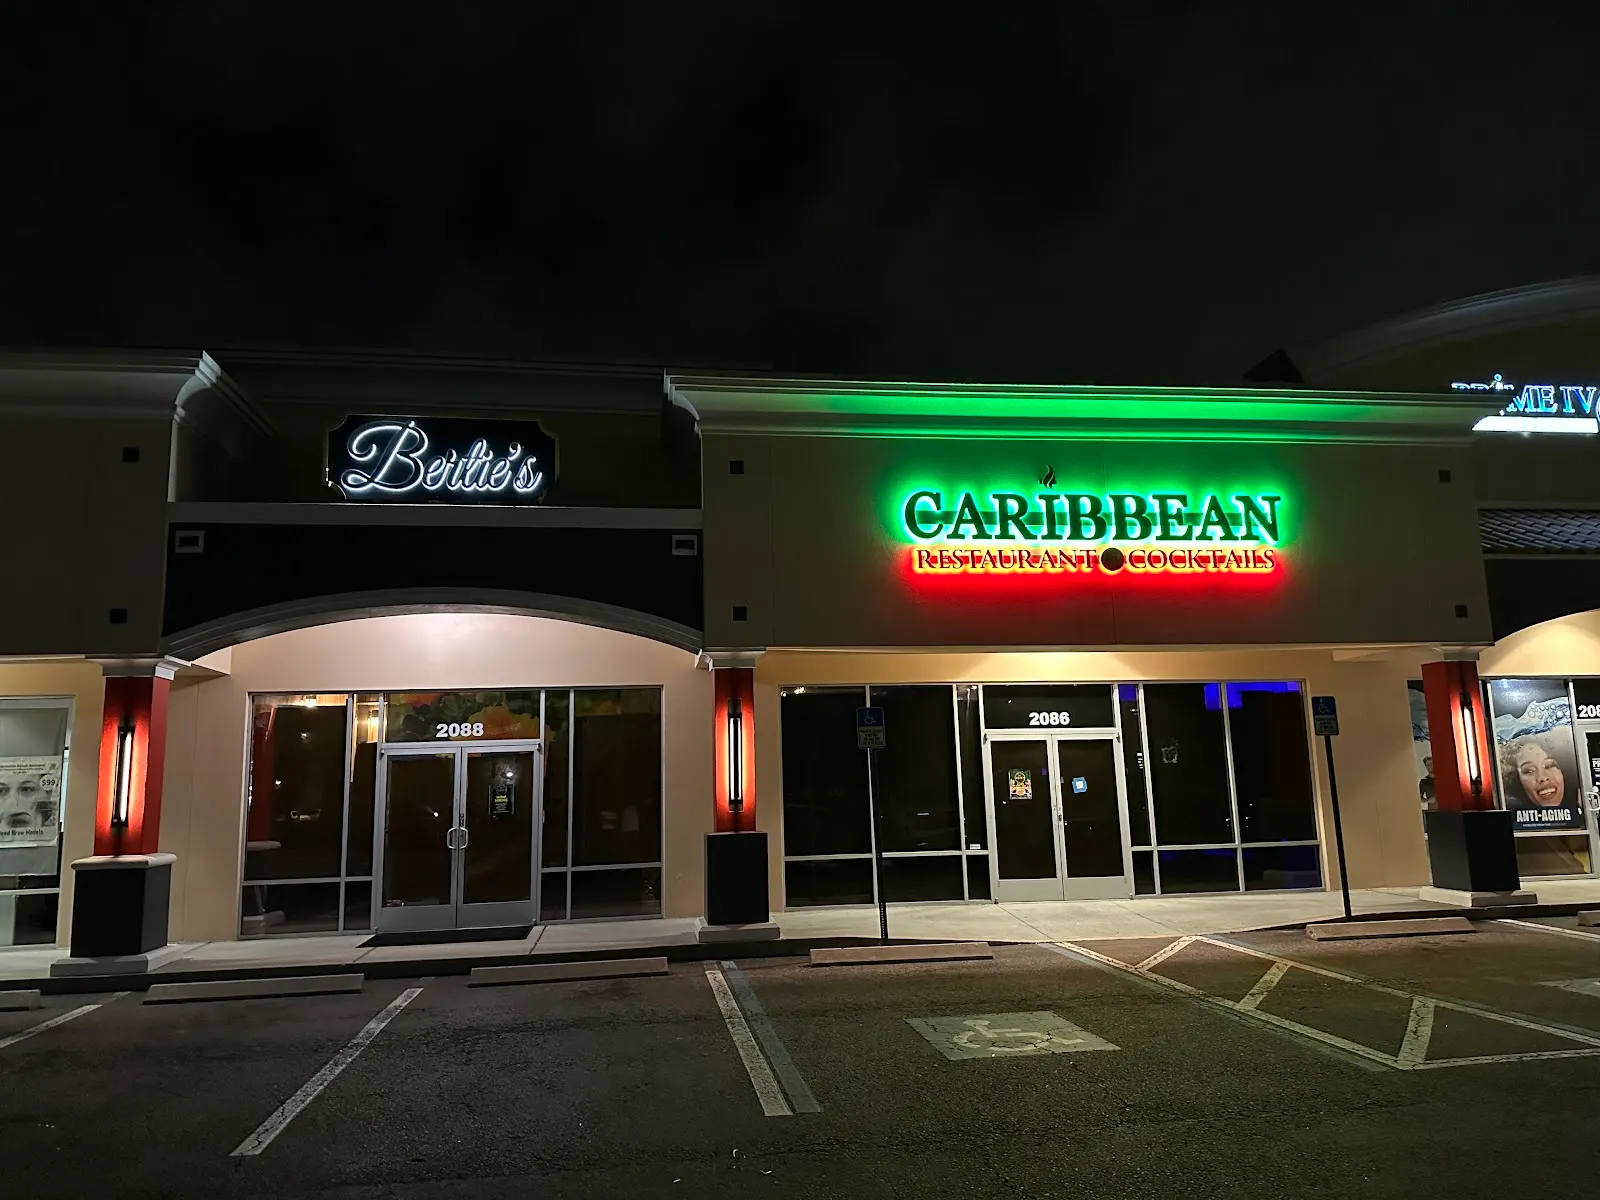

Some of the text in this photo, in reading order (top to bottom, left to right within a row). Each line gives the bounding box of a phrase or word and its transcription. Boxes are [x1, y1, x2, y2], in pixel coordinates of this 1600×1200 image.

[1560, 387, 1597, 413] IV
[904, 491, 1281, 542] CARIBBEAN
[916, 549, 1275, 570] RESTAURANT COCKTAILS
[1029, 712, 1070, 726] 2086
[436, 723, 483, 738] 2088
[41, 779, 56, 787] $99
[1516, 809, 1572, 822] ANTI-AGING
